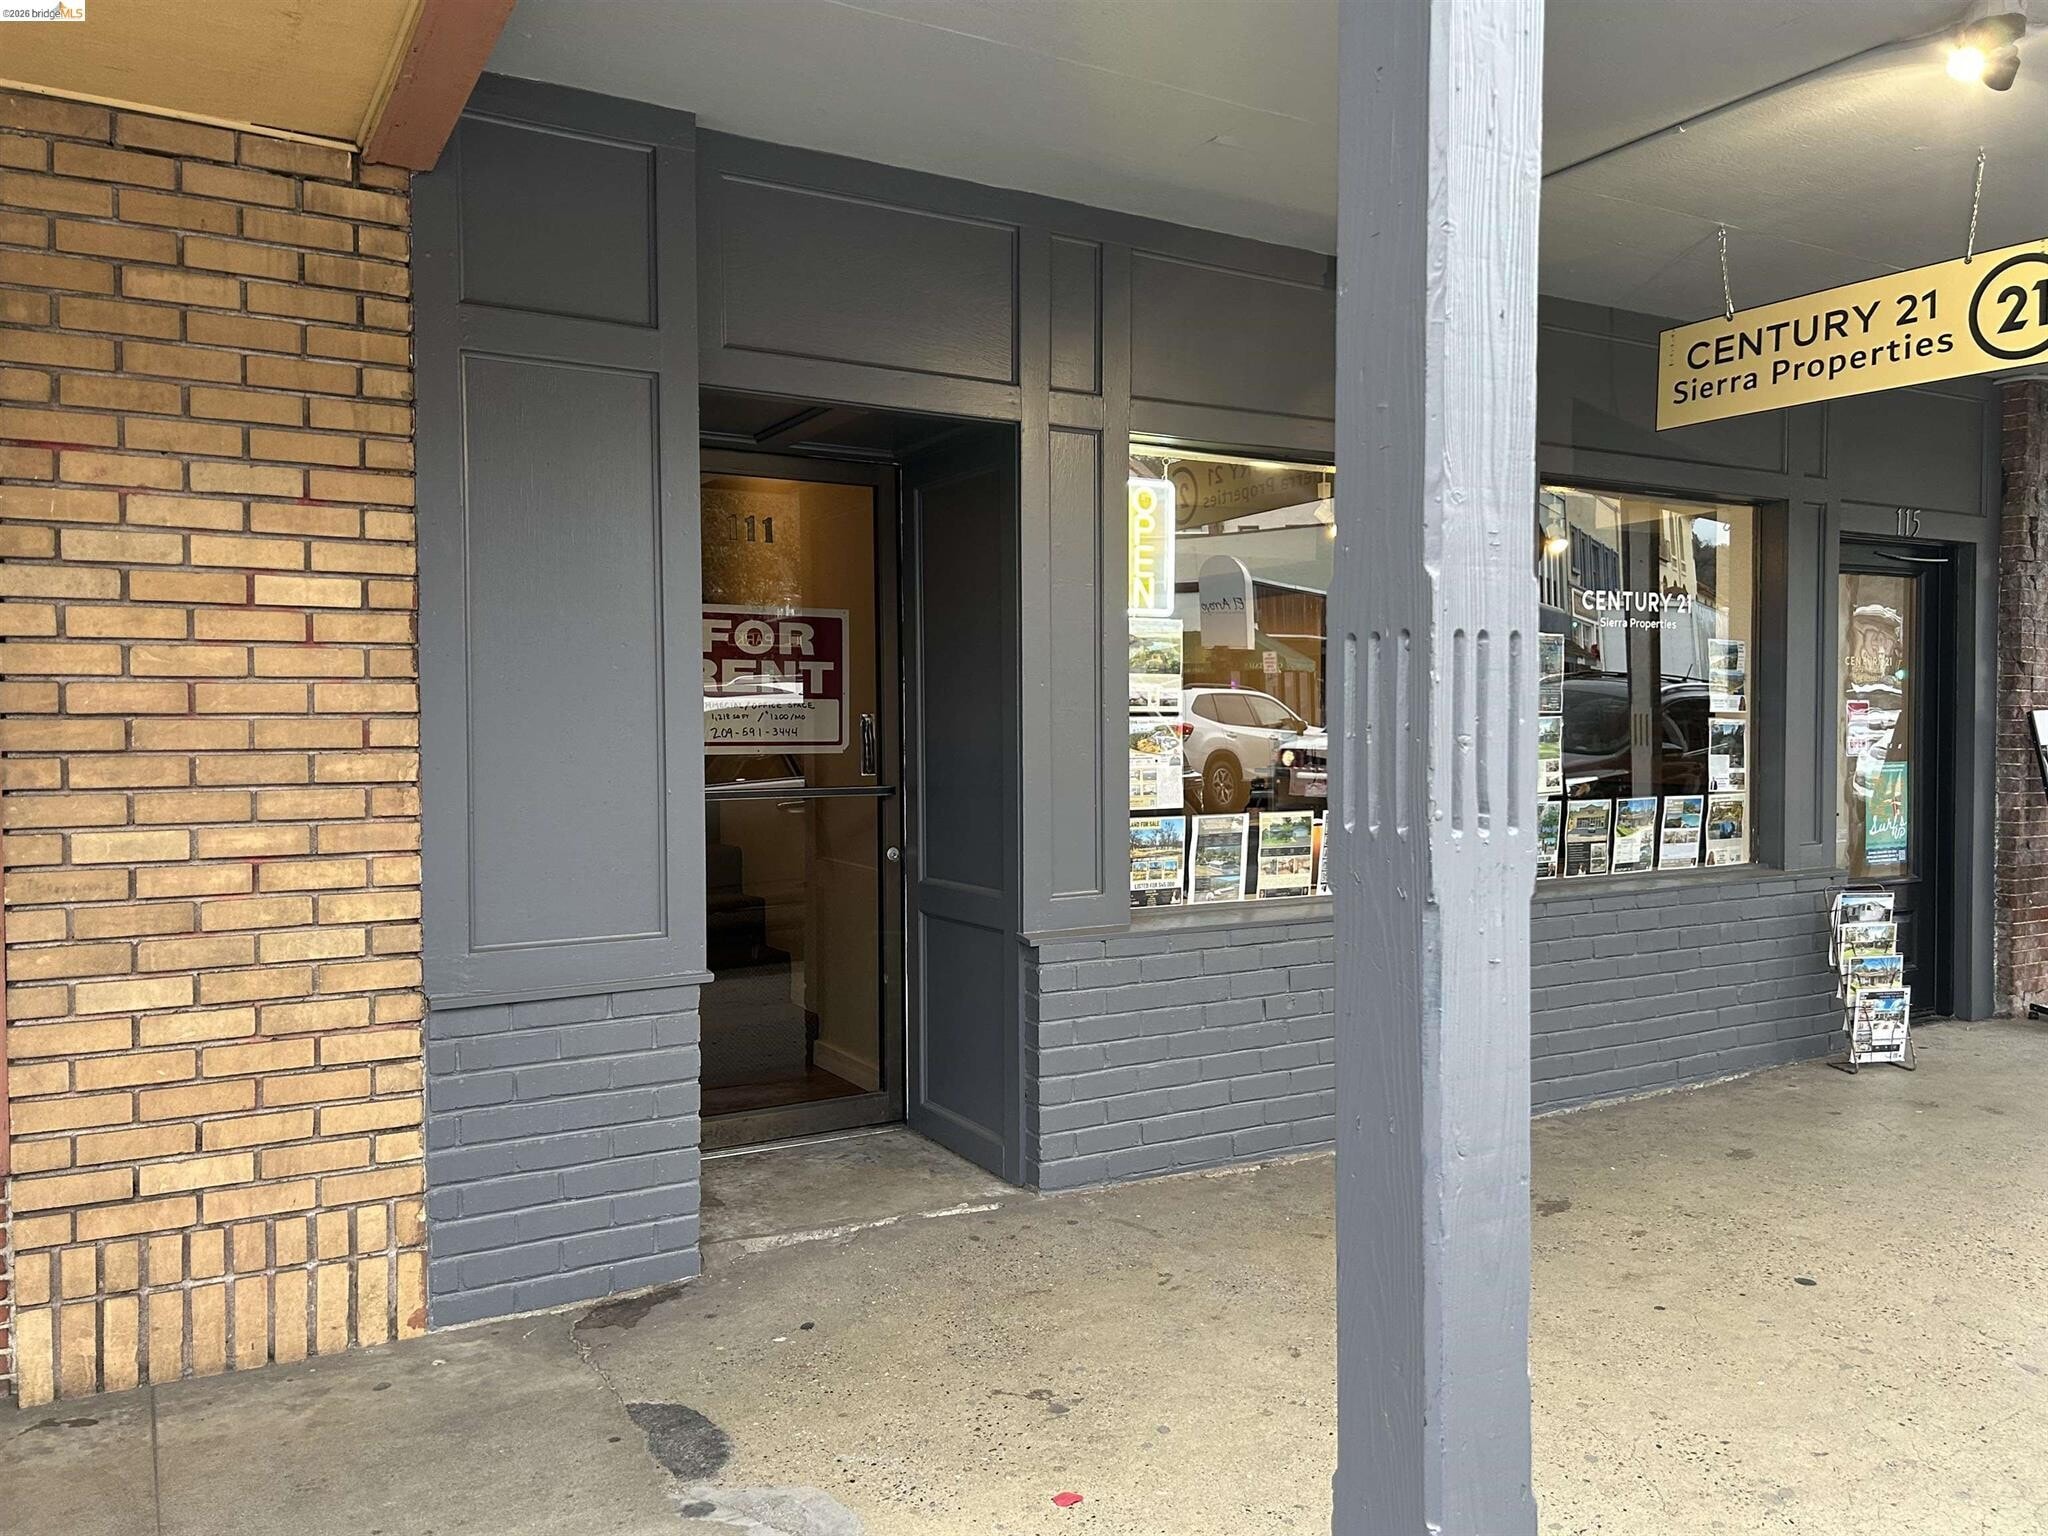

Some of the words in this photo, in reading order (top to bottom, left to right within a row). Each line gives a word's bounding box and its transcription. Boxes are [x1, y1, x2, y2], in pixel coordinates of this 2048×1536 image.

[1996, 279, 2048, 334] 21
[1686, 300, 1881, 370] CENTURY
[1896, 289, 1937, 327] 21
[1672, 369, 1758, 405] Sierra
[1771, 332, 1954, 385] Properties
[727, 513, 774, 544] 111
[1896, 507, 1921, 537] 115
[1132, 486, 1159, 610] OPEN
[1581, 590, 1673, 613] CENTURY
[1676, 593, 1692, 614] 21
[703, 619, 815, 656] FOR
[1600, 617, 1628, 629] Sierra
[1629, 618, 1677, 631] Properties
